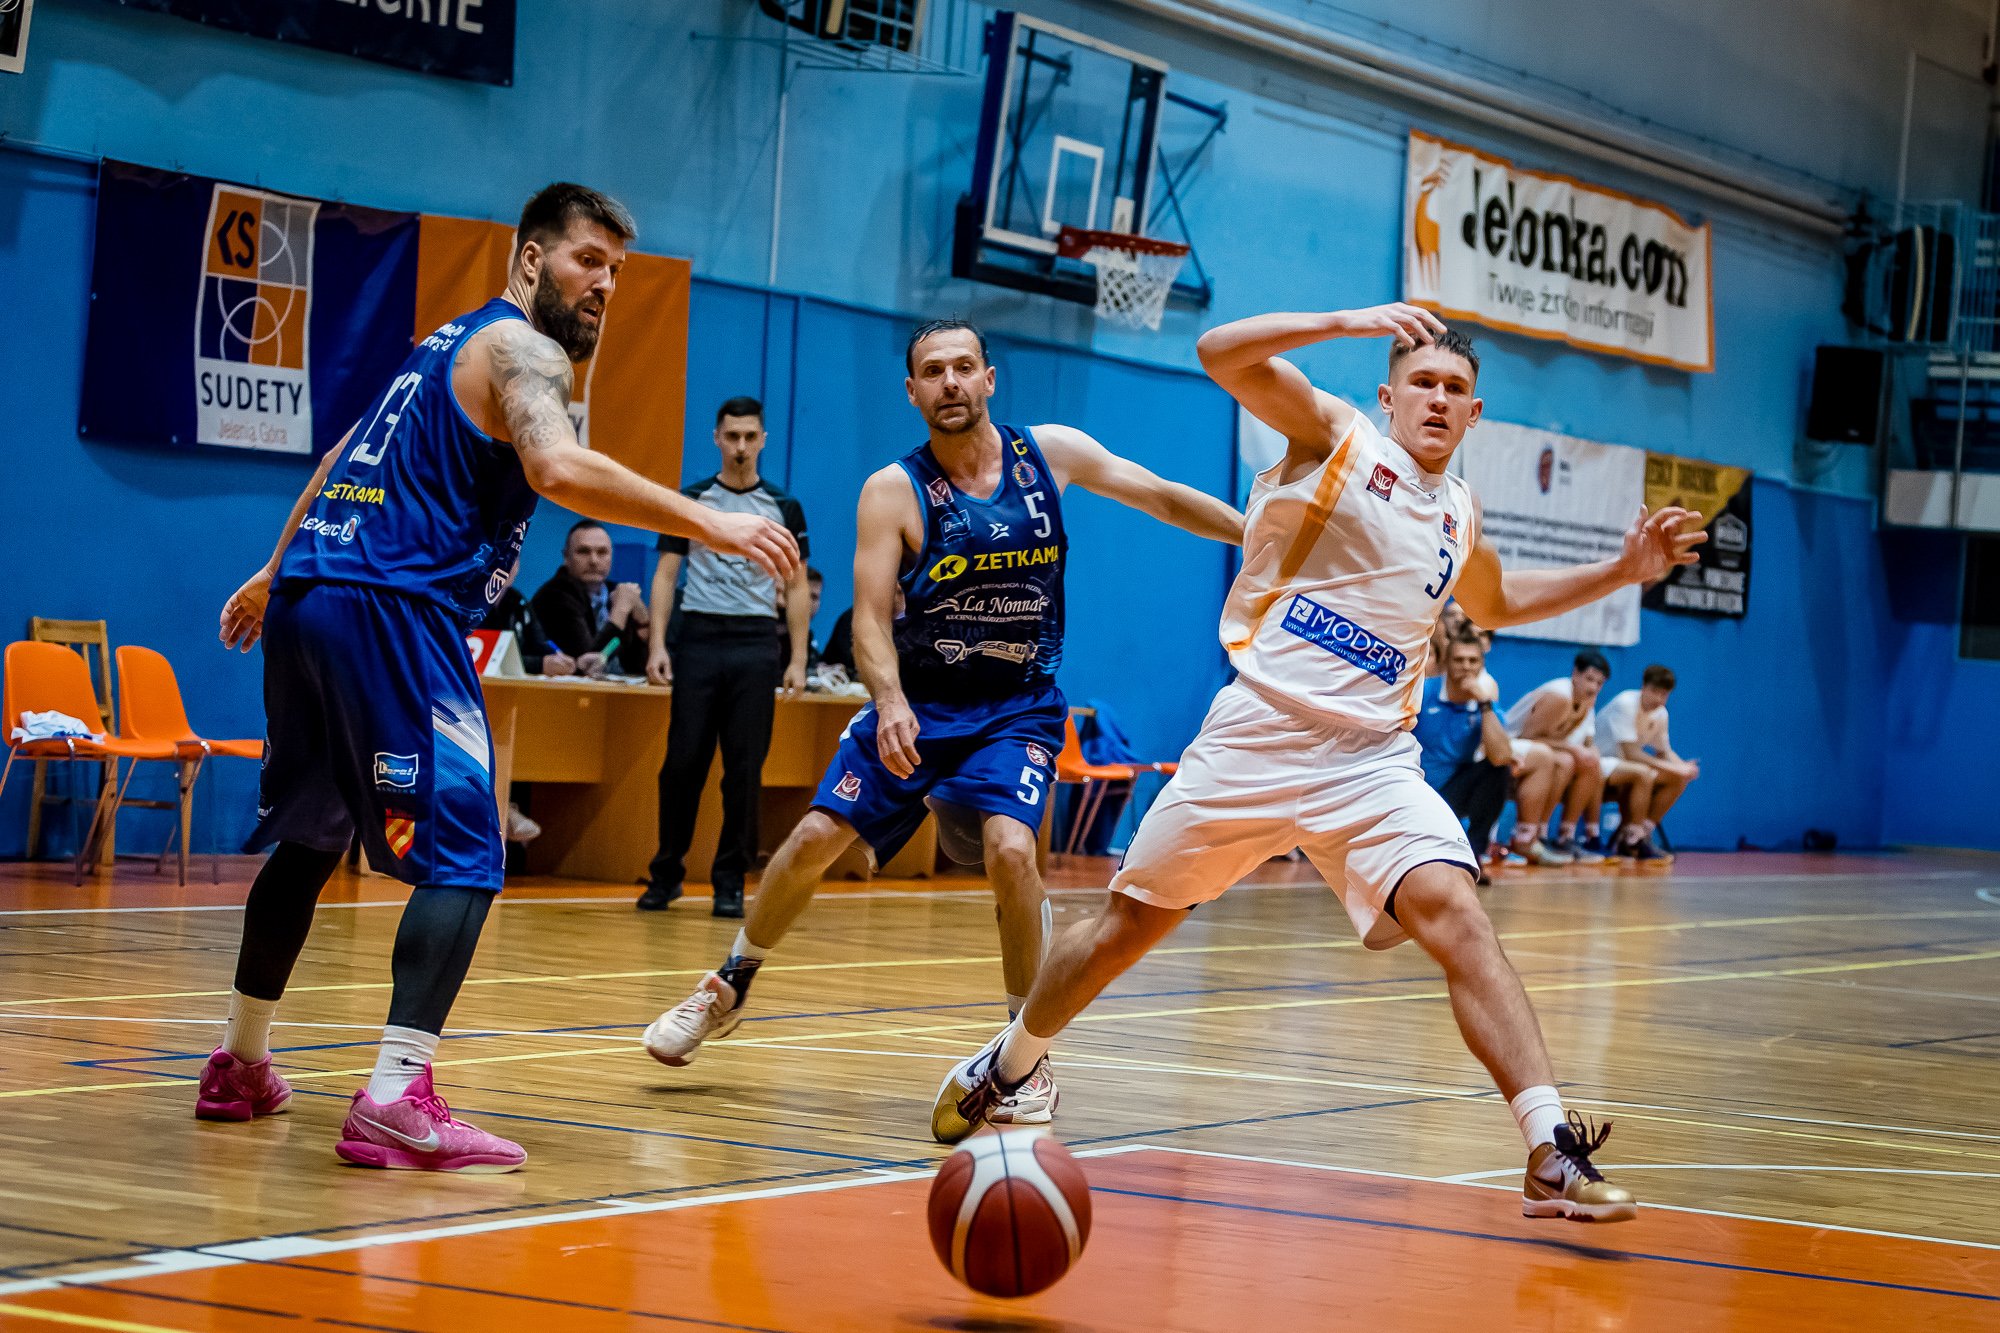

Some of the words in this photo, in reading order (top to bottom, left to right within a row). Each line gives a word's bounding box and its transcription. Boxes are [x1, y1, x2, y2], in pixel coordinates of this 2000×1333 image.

[217, 210, 255, 268] KS
[201, 371, 303, 416] SUDETY
[1024, 491, 1052, 538] 5
[940, 559, 963, 577] K
[1424, 547, 1454, 600] 3
[962, 595, 986, 613] La
[987, 597, 1042, 614] Nonna
[1016, 765, 1044, 806] 5
